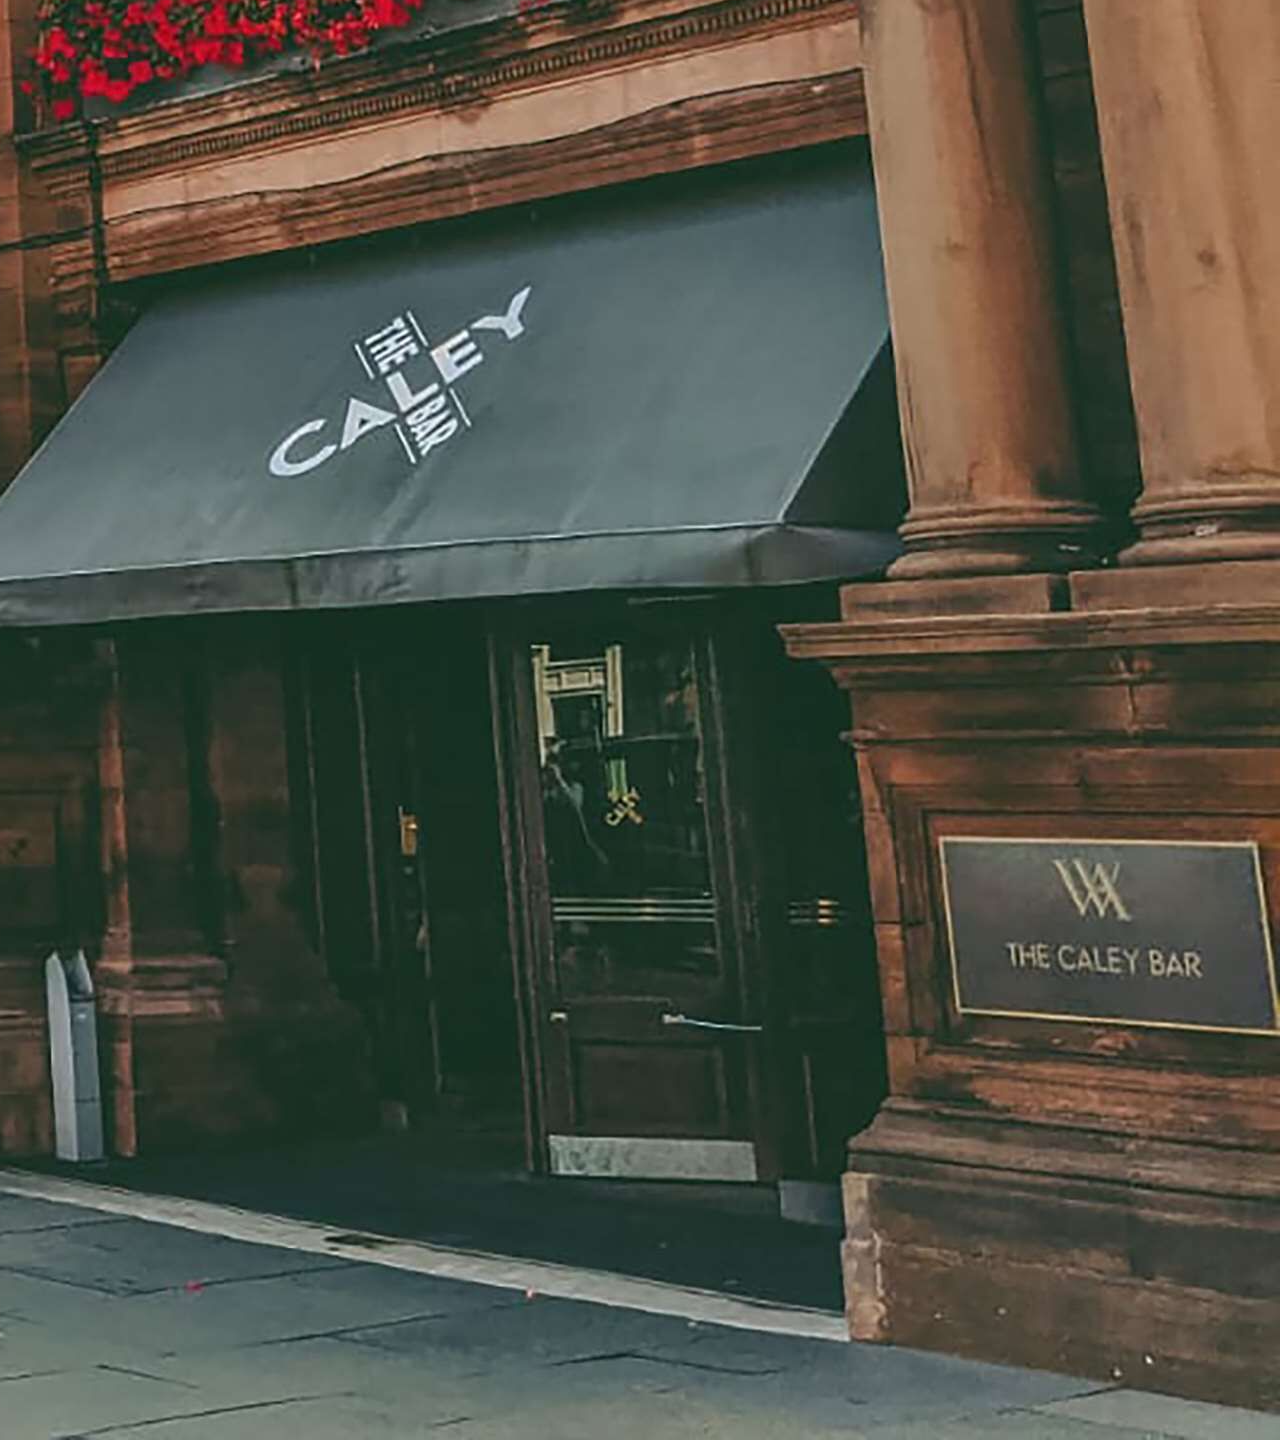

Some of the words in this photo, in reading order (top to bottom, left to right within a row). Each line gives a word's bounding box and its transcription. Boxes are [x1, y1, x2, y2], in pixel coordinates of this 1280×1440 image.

[364, 316, 420, 374] THE
[269, 286, 532, 477] CALEY
[405, 391, 459, 457] BAR
[1005, 941, 1051, 969] THE
[1057, 944, 1140, 975] CALEY
[1148, 949, 1204, 978] BAR
